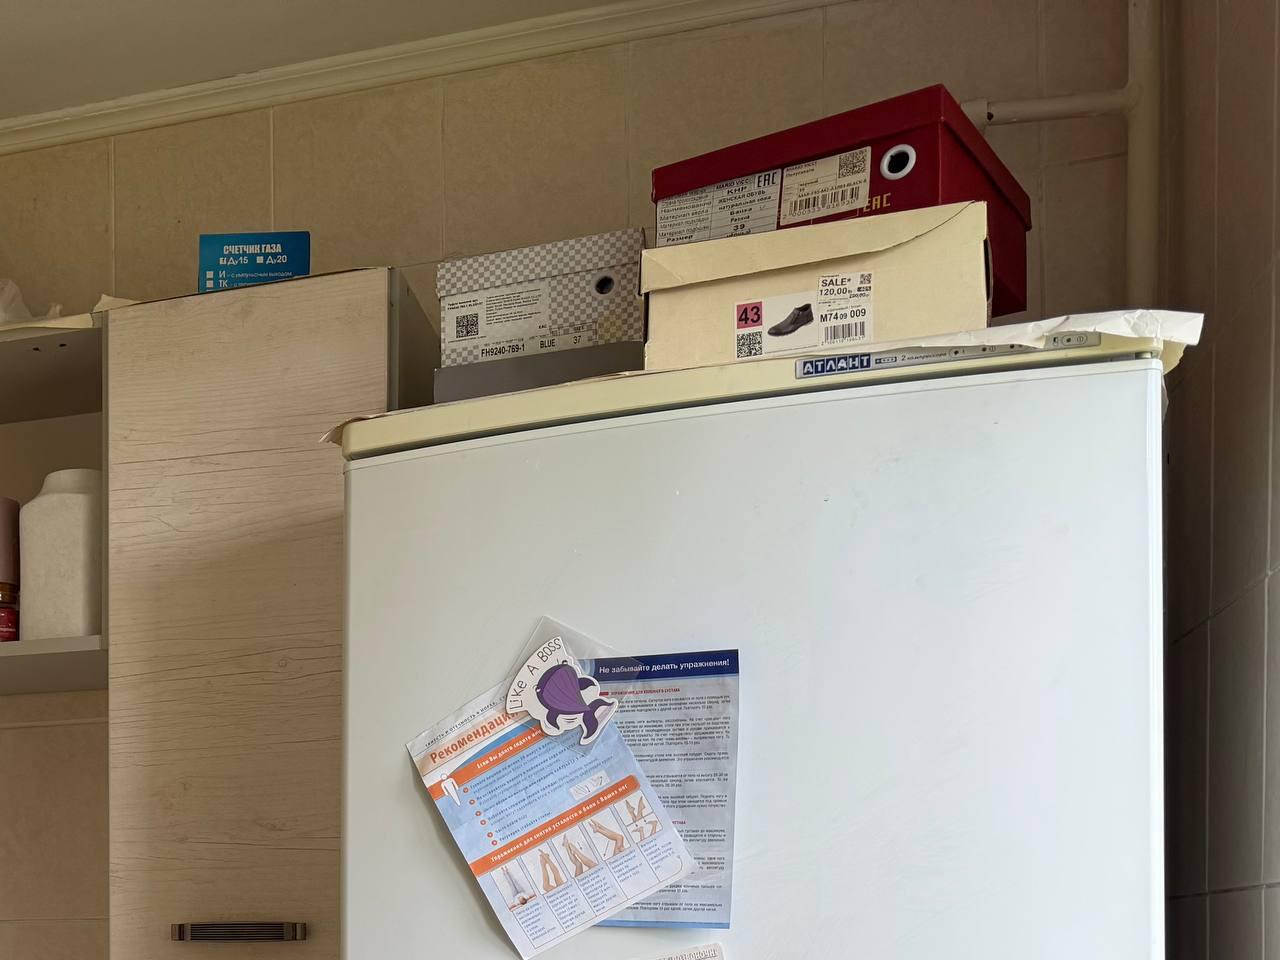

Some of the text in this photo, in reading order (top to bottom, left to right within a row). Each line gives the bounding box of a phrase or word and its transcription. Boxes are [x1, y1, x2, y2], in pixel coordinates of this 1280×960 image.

[757, 171, 777, 188] EAC
[727, 186, 747, 195] КНР
[733, 223, 745, 231] 39
[223, 243, 282, 255] СЧЕТЧИК ГАЗА
[738, 305, 761, 325] 43
[820, 312, 839, 323] M74
[850, 308, 867, 319] 009
[481, 343, 525, 358] FH9240-769-1
[539, 339, 556, 349] BLUE
[573, 335, 582, 345] 37
[803, 354, 870, 375] АТЛАНТ
[527, 664, 539, 676] A
[536, 637, 562, 663] BOSS
[599, 658, 730, 674] Не забывайте делать упражнения!
